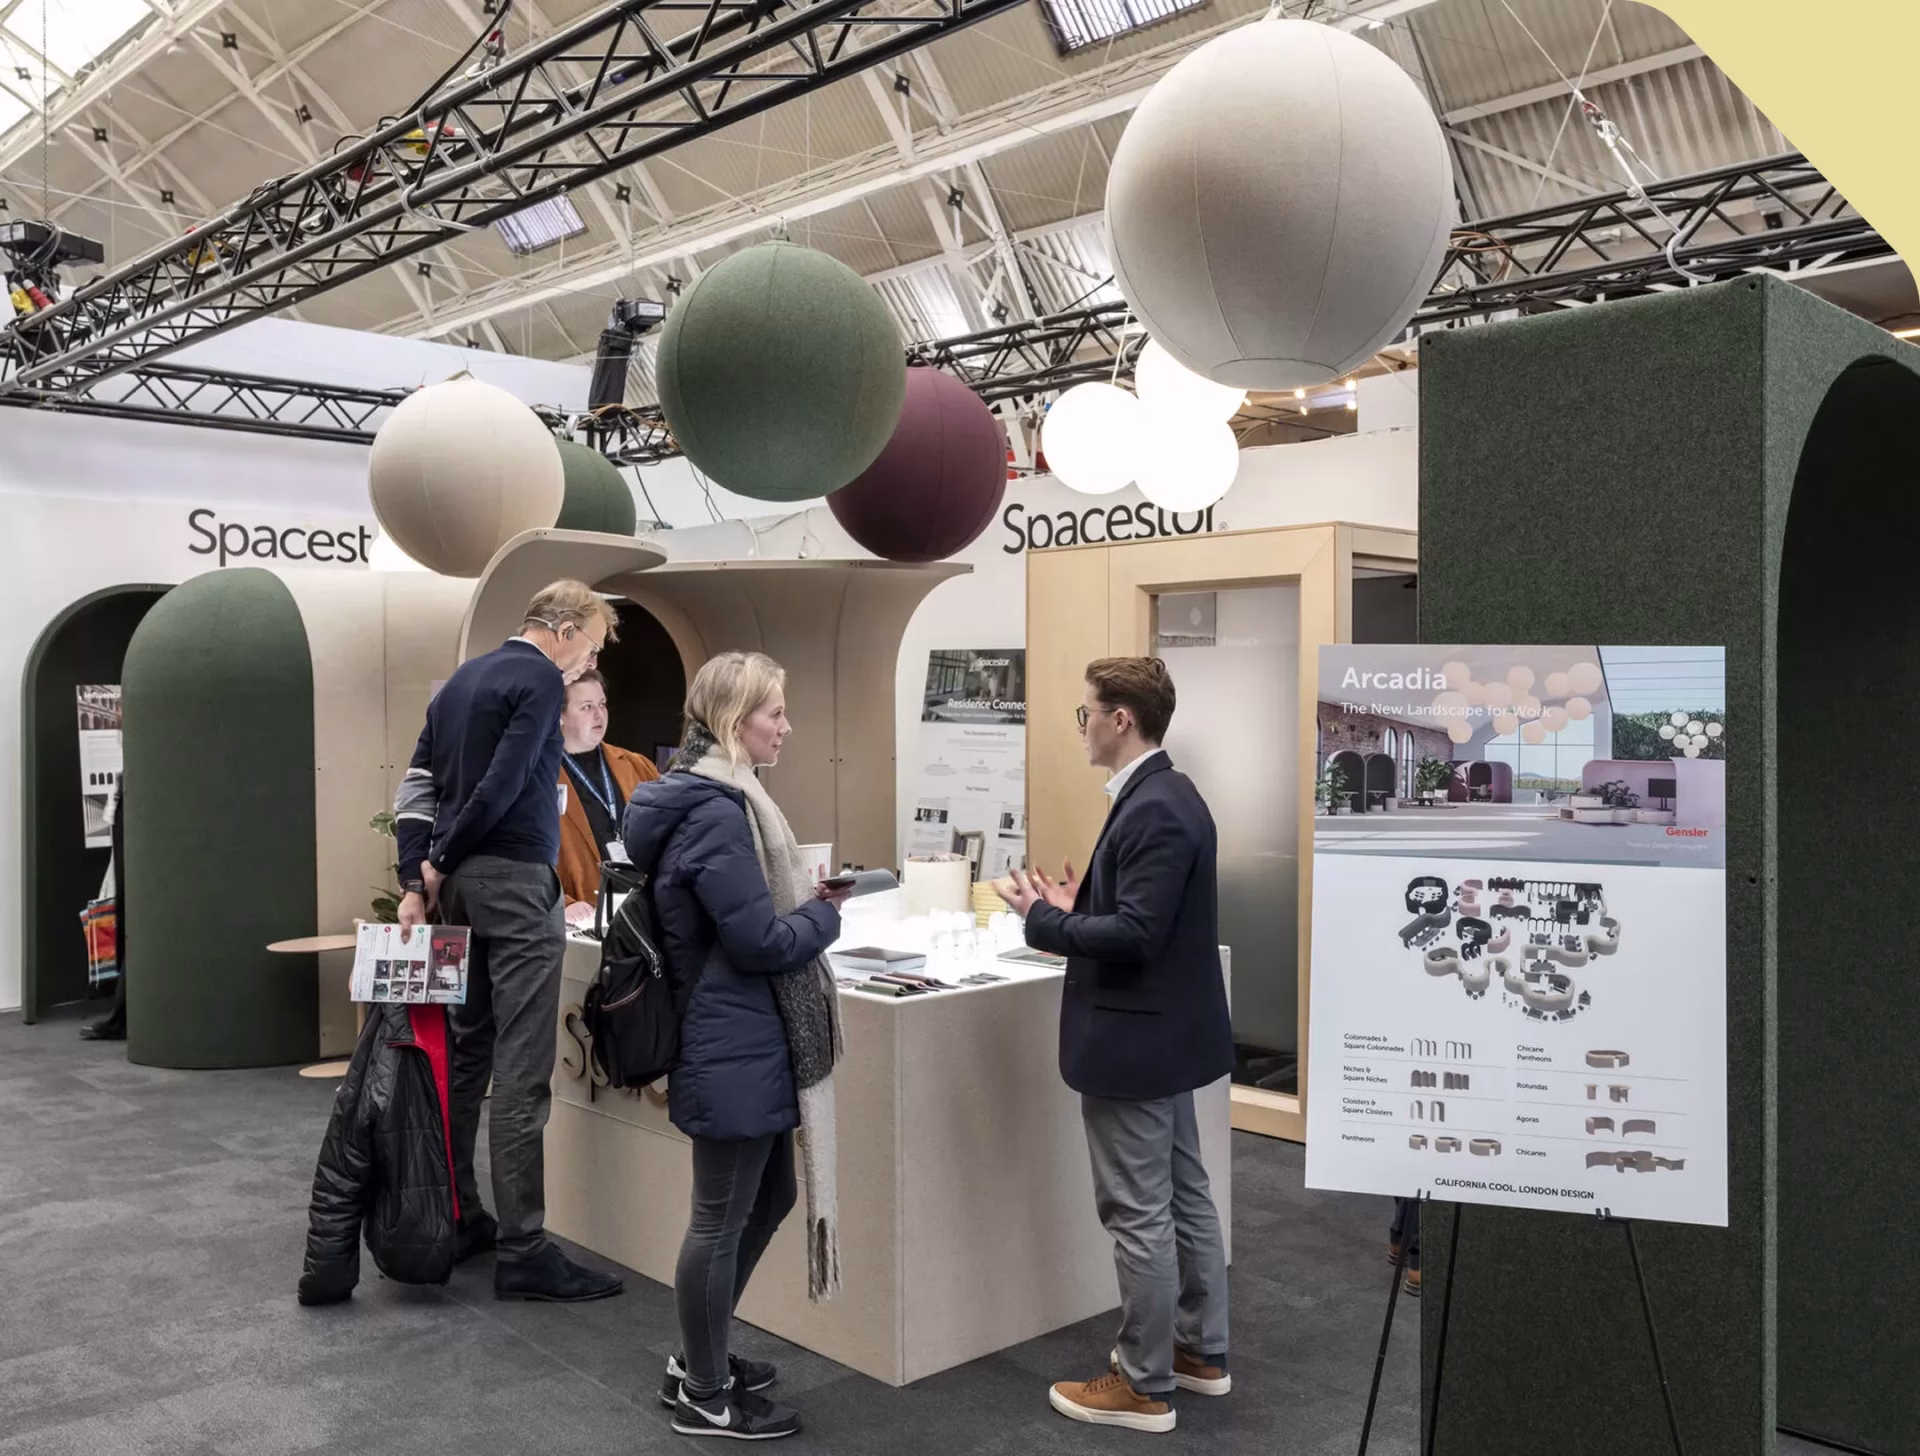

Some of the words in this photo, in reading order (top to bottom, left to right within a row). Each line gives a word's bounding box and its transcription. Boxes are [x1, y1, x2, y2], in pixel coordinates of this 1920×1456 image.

[1341, 666, 1447, 690] Arcadia
[947, 698, 991, 709] Residence
[1341, 702, 1367, 715] The
[1371, 703, 1403, 715] New
[1407, 704, 1484, 719] Landscape
[1487, 704, 1508, 716] for
[1512, 704, 1551, 718] Work
[1666, 826, 1709, 837] Gensler
[1344, 1033, 1381, 1042] Colonnades
[1344, 1042, 1366, 1050] Square
[1367, 1043, 1404, 1052] Colonnades
[1517, 1045, 1544, 1053] Chicane
[1517, 1054, 1552, 1063] Pantheons
[1343, 1065, 1365, 1073] Niches
[1343, 1074, 1365, 1082] Square
[1516, 1082, 1548, 1091] Rotundas
[1342, 1097, 1370, 1106] Cloisters
[1342, 1106, 1364, 1114] Square
[1365, 1107, 1393, 1116] Cloisters
[1516, 1115, 1540, 1124] Agoras
[1341, 1134, 1375, 1143] Pantheons
[1516, 1148, 1547, 1157] Chicanes
[1434, 1177, 1487, 1190] CALIFORNIA
[1519, 1185, 1558, 1197] LONDON
[1560, 1188, 1595, 1200] DESIGN
